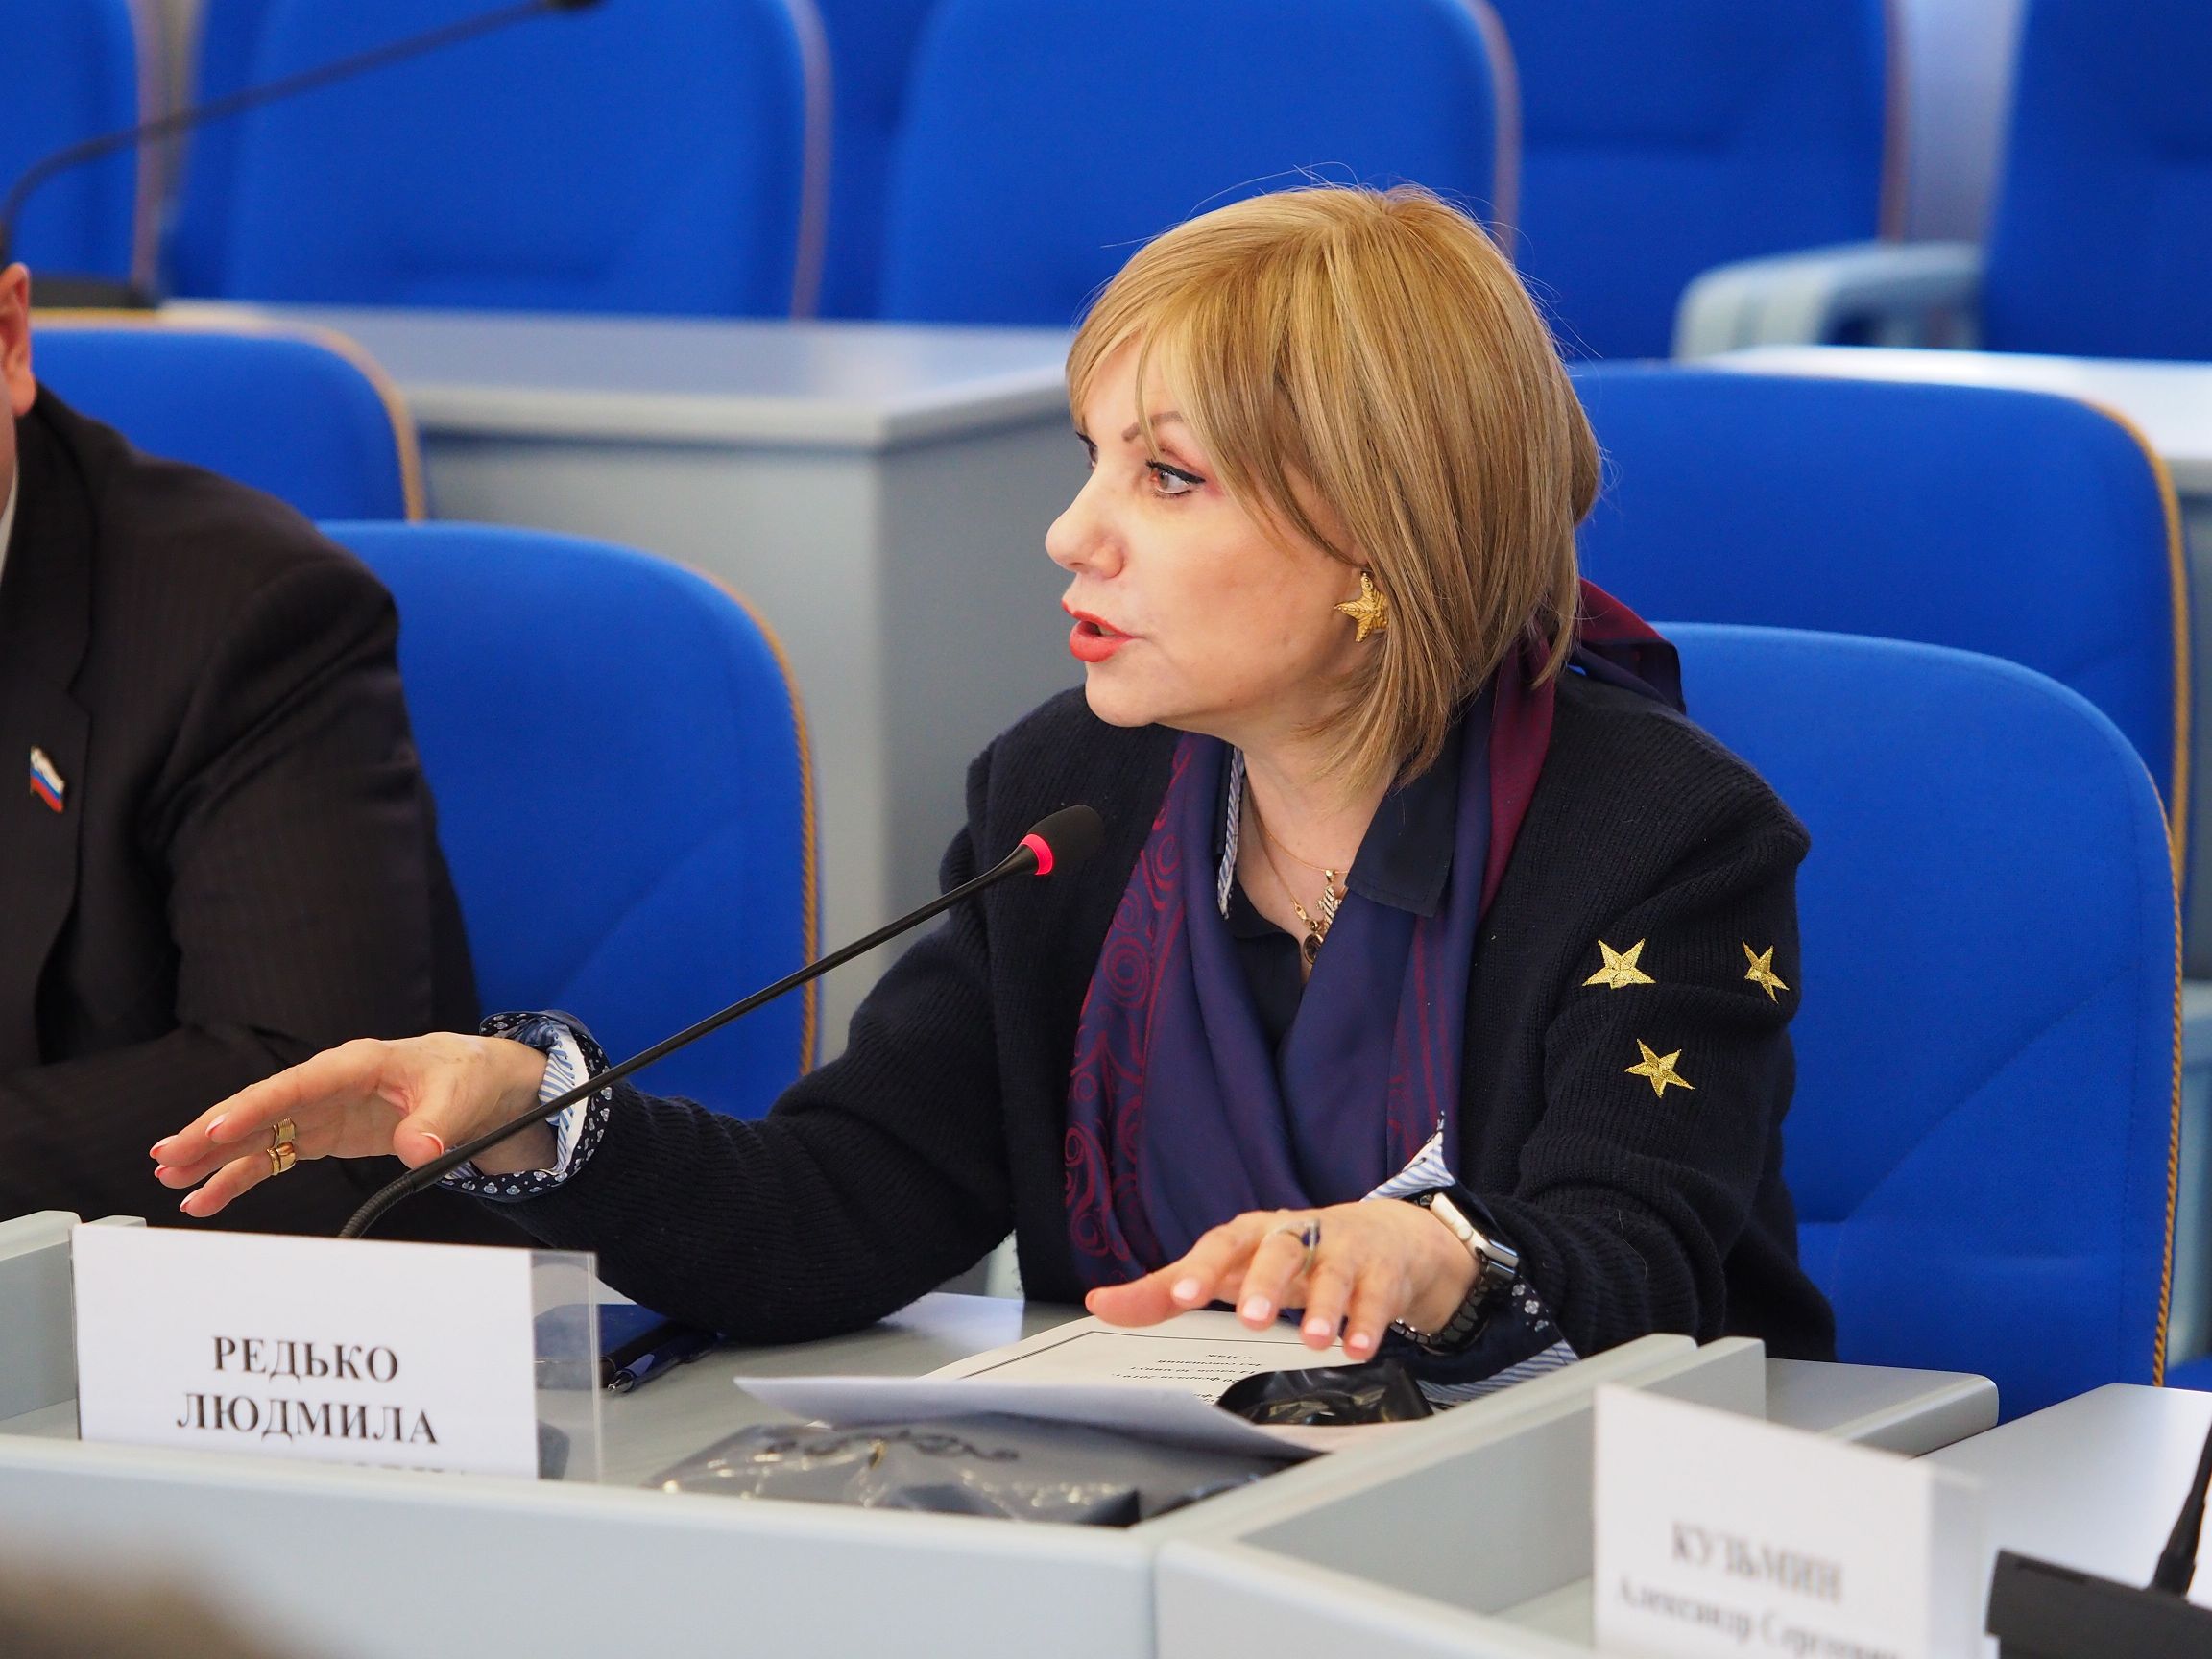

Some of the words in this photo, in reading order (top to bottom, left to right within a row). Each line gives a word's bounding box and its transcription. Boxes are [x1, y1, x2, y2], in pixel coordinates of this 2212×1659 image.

[211, 1335, 399, 1383] РЕДЬКО
[177, 1393, 438, 1445] ЛЮДМИЛА
[1671, 1521, 1845, 1605] КУЗЬМИН
